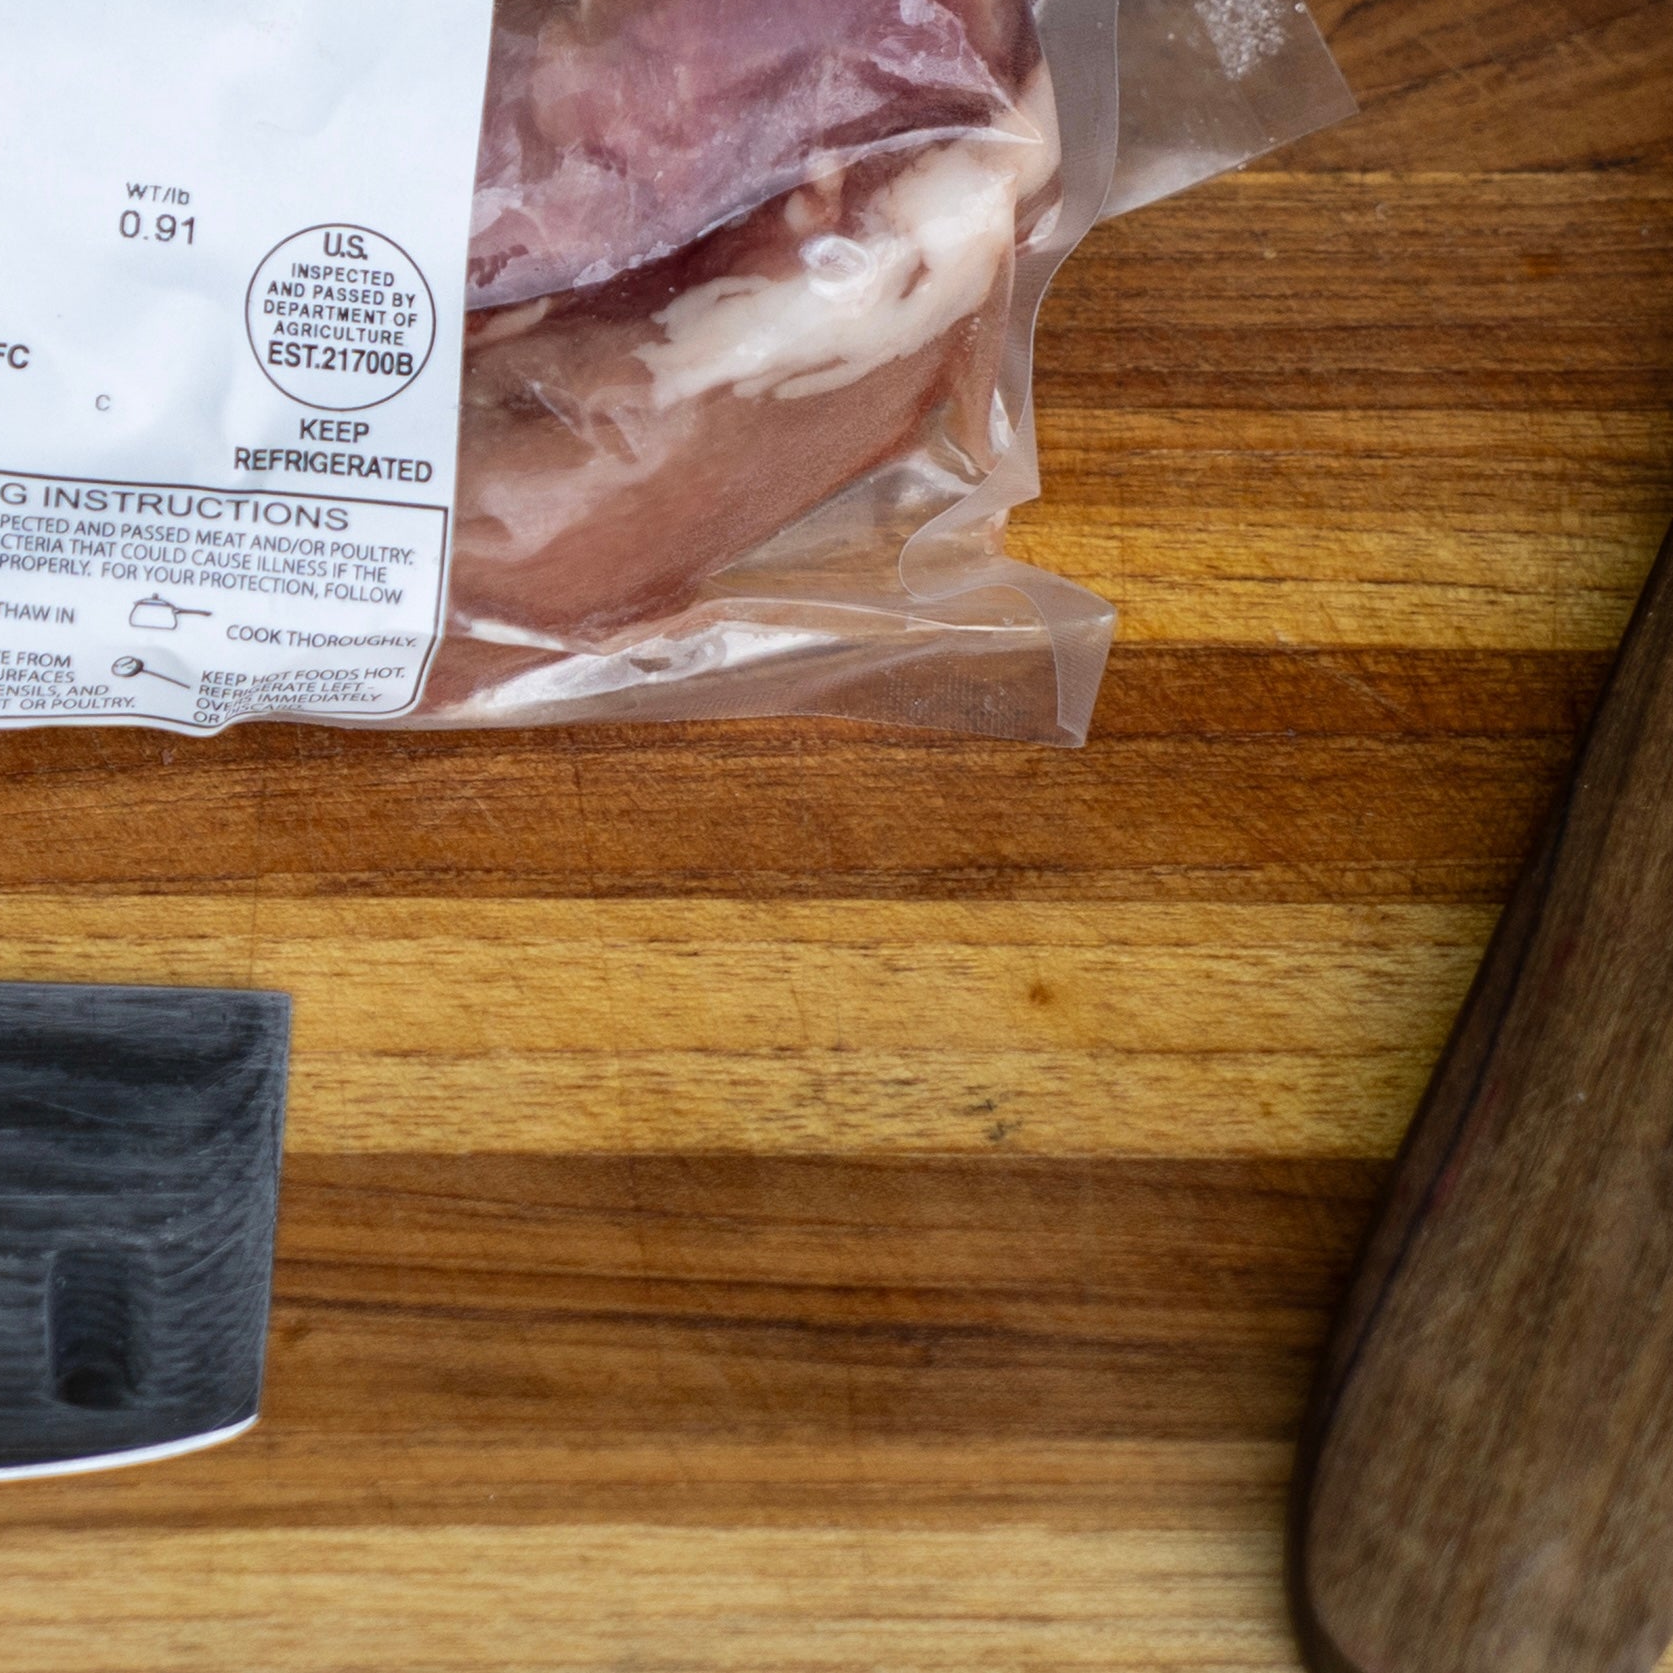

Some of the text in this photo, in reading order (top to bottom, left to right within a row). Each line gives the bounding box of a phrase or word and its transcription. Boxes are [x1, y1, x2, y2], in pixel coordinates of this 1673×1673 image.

[125, 181, 190, 206] WT/lb
[119, 209, 195, 246] 0.91
[323, 231, 369, 261] U.S.
[291, 262, 396, 288] INSPECTED
[266, 280, 416, 310] AND PASSED BY
[263, 299, 419, 329] DEPARTMENT OF
[272, 320, 405, 347] AGRICULTURE
[267, 340, 414, 378] EST.21700B
[299, 418, 370, 444] KEEP
[233, 446, 434, 484] REFRIGERATED
[42, 485, 350, 532] INSTRUCTIONS
[73, 520, 117, 538] AND
[120, 523, 191, 544] PASSED
[194, 529, 247, 549] MEAT
[249, 534, 326, 557] AND/OR
[68, 537, 118, 559] THAT
[120, 542, 187, 565] COULD
[191, 548, 252, 571] CAUSE
[256, 555, 328, 578] ILLNESS
[332, 562, 348, 579] IF
[351, 563, 388, 584] THE
[100, 561, 138, 580] FOR
[142, 564, 195, 586] YOUR
[198, 569, 319, 600] PROTECTION,
[323, 581, 404, 606] FOLLOW
[55, 606, 76, 625] IN
[226, 624, 417, 648] COOK THOROUGHLY.
[15, 650, 72, 668] FROM
[201, 666, 406, 687] KEEP HOT FOODS HOT.
[18, 697, 48, 710] OR
[50, 696, 137, 710] POULTRY.
[65, 684, 110, 697] AND
[257, 692, 384, 704] IMMEDIATELY
[192, 710, 221, 725] OR
